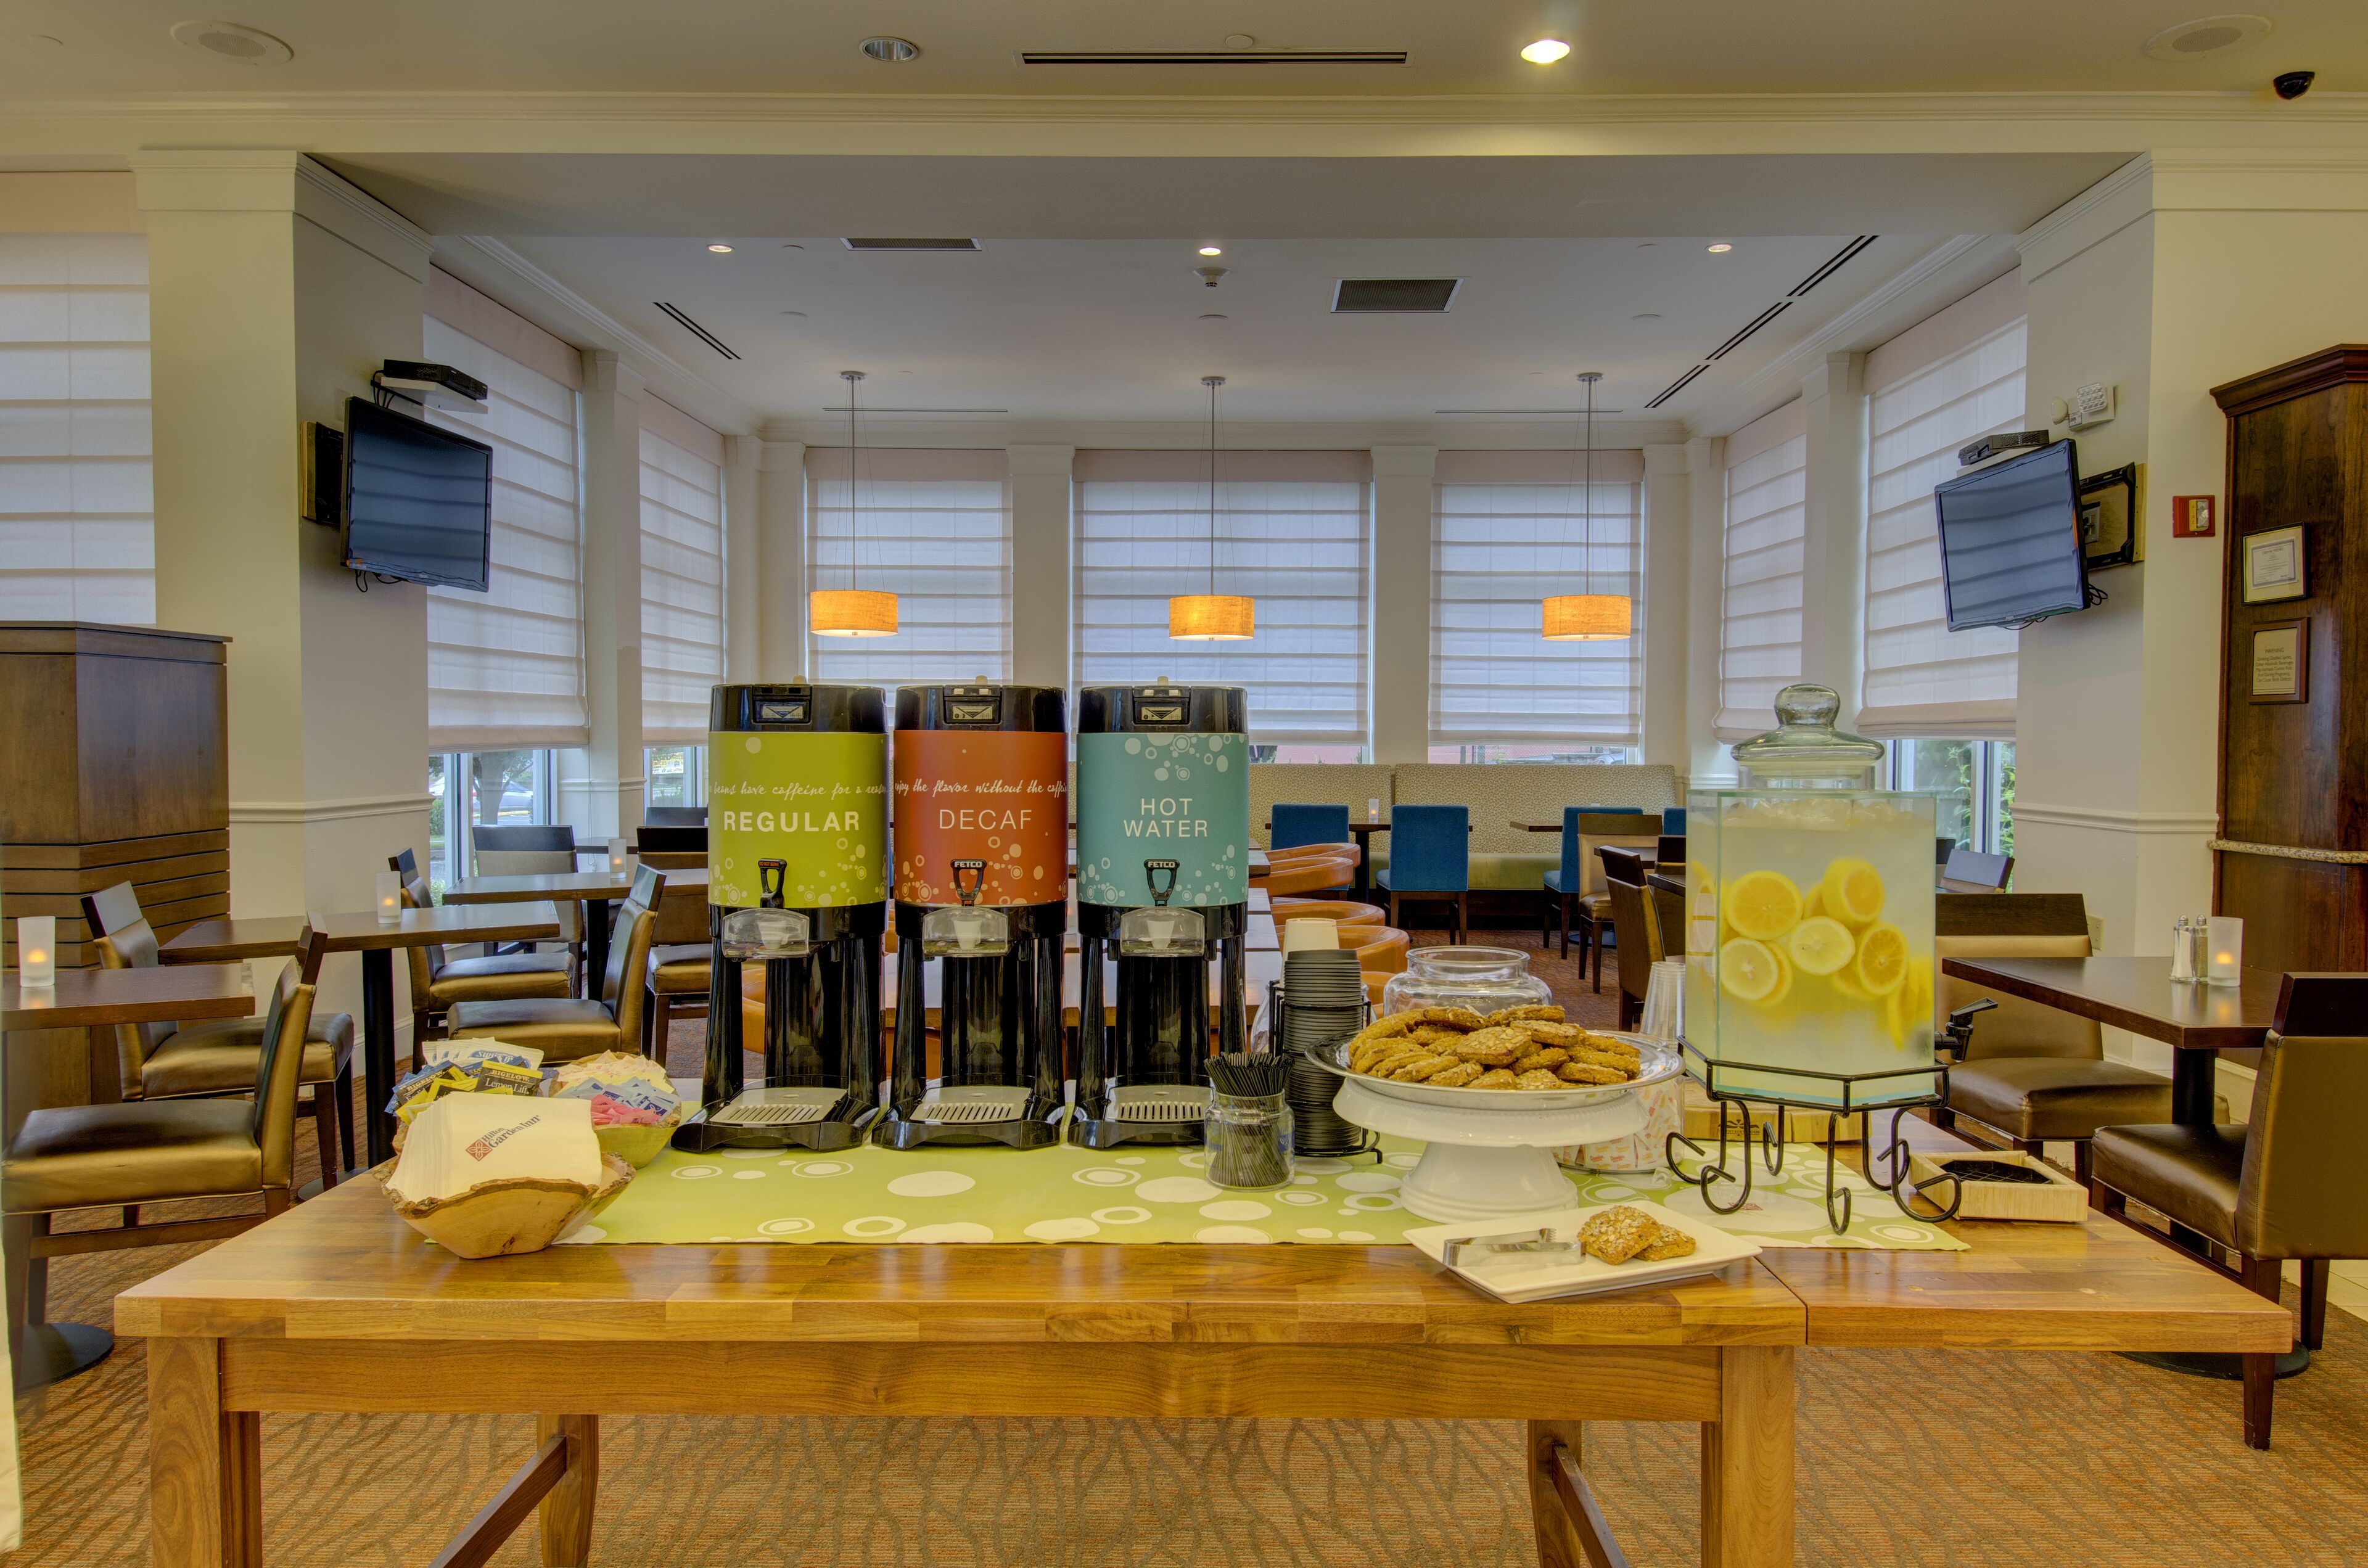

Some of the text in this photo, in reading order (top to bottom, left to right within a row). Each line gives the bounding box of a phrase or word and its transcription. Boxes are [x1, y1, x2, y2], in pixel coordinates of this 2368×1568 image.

[713, 781, 736, 795] beans
[740, 781, 766, 795] have
[771, 782, 826, 800] caffeine
[830, 782, 852, 800] for
[856, 786, 862, 794] a
[913, 778, 929, 792] the
[932, 779, 969, 798] flavor
[975, 779, 1024, 794] without
[1026, 779, 1044, 794] the
[1047, 780, 1067, 798] caffei
[1141, 798, 1193, 816] HOT
[724, 811, 860, 832] REGULAR
[939, 810, 1032, 830] DECAF
[1124, 819, 1207, 837] WATER
[481, 1127, 505, 1142] Hilton
[488, 1125, 525, 1147] Garden
